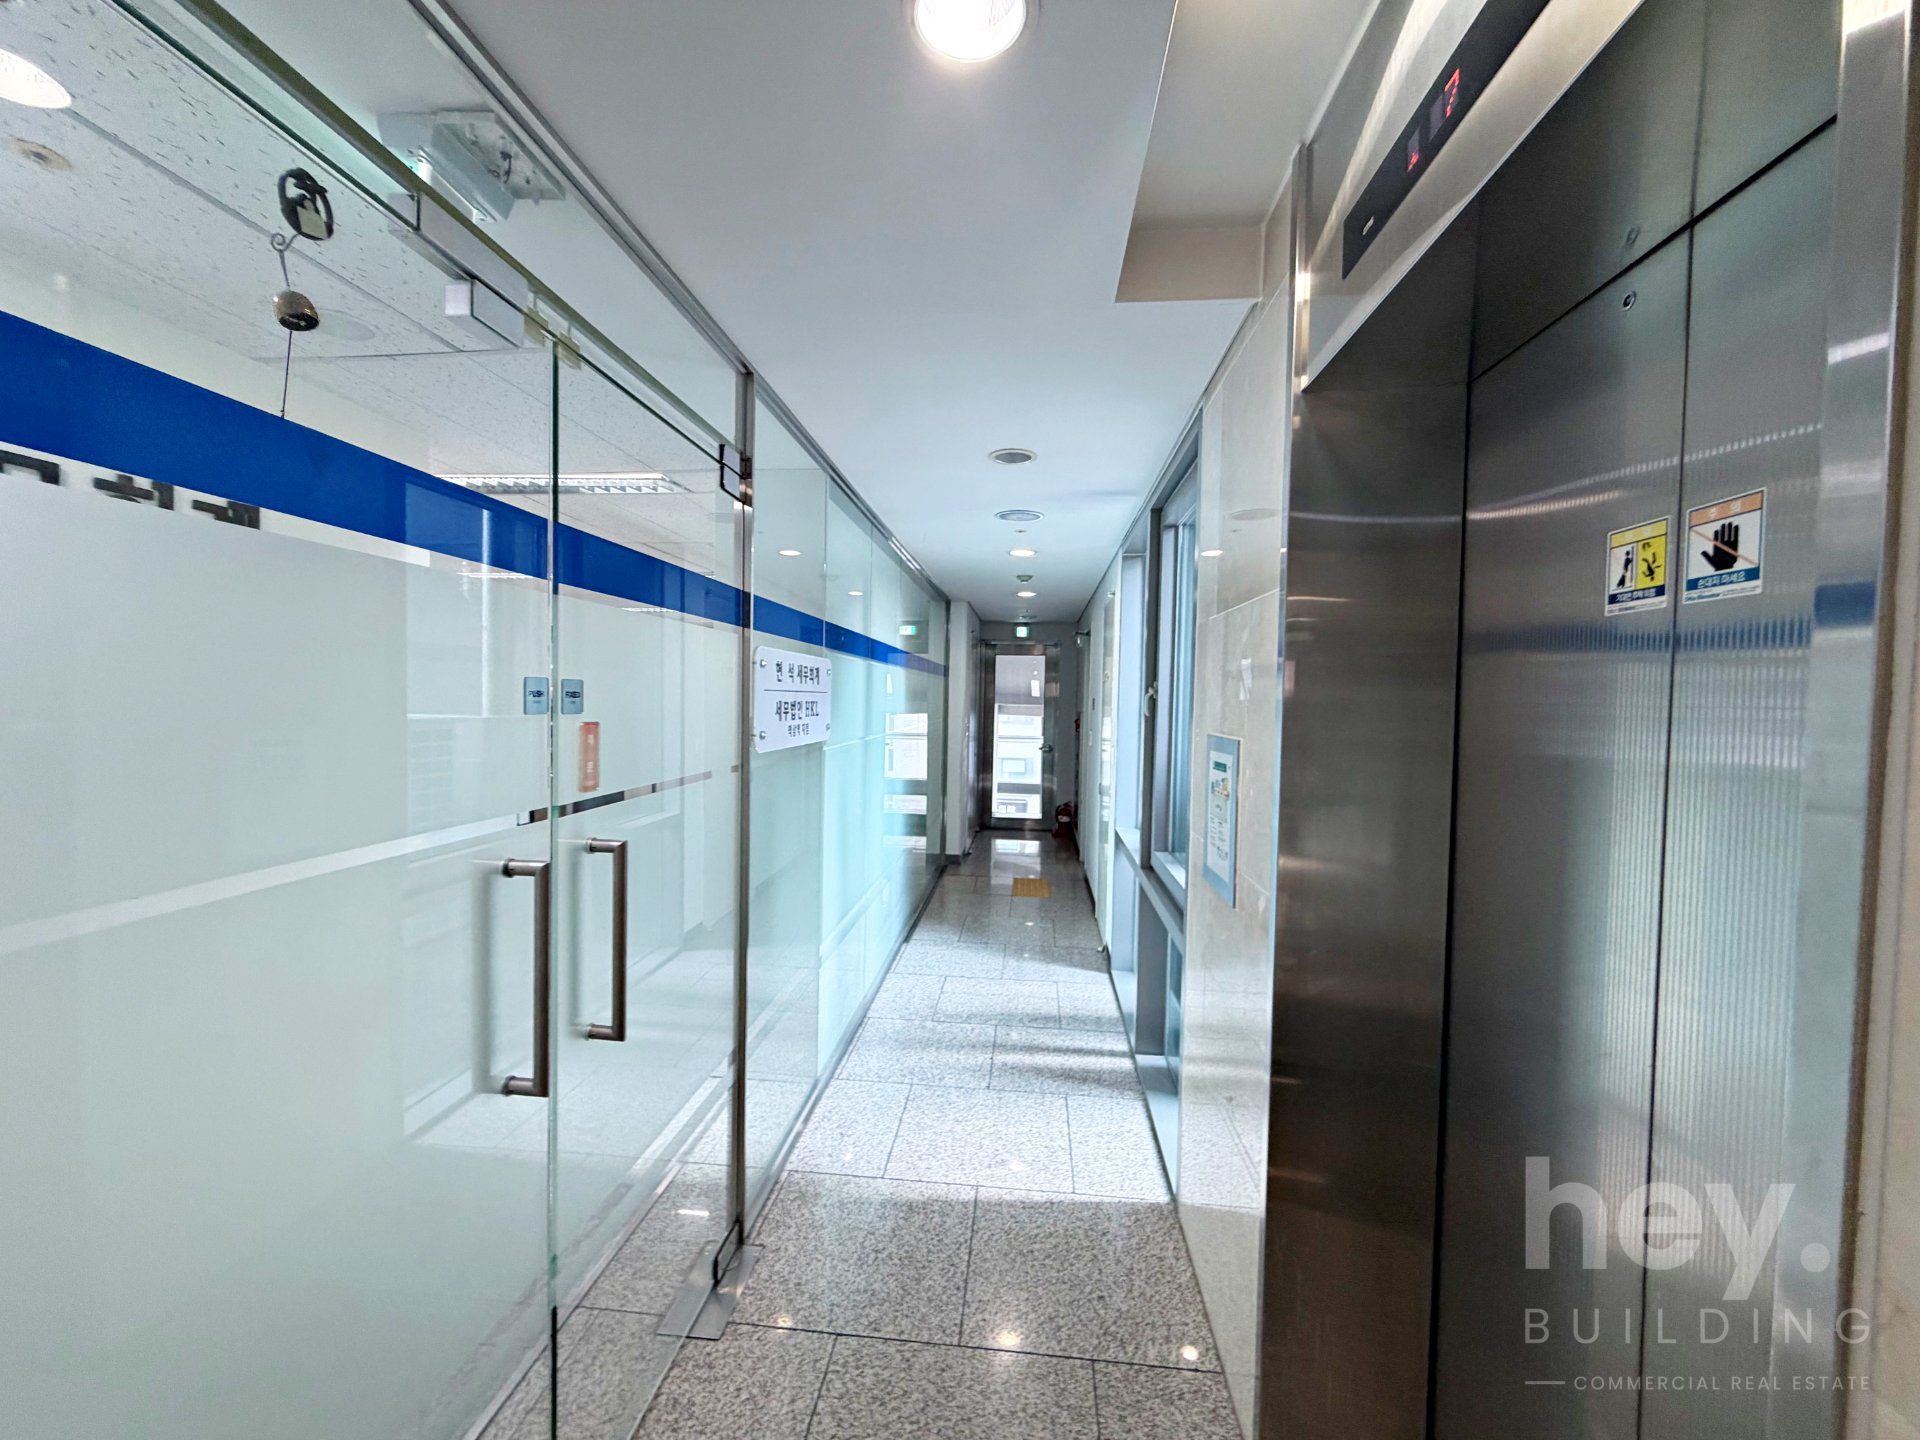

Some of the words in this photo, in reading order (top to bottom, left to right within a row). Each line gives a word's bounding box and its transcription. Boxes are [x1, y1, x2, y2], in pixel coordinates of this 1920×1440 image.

[1697, 575, 1721, 589] 손대지
[1721, 571, 1746, 584] 마세요
[797, 664, 820, 686] 세무회계
[775, 700, 803, 721] 세무법인
